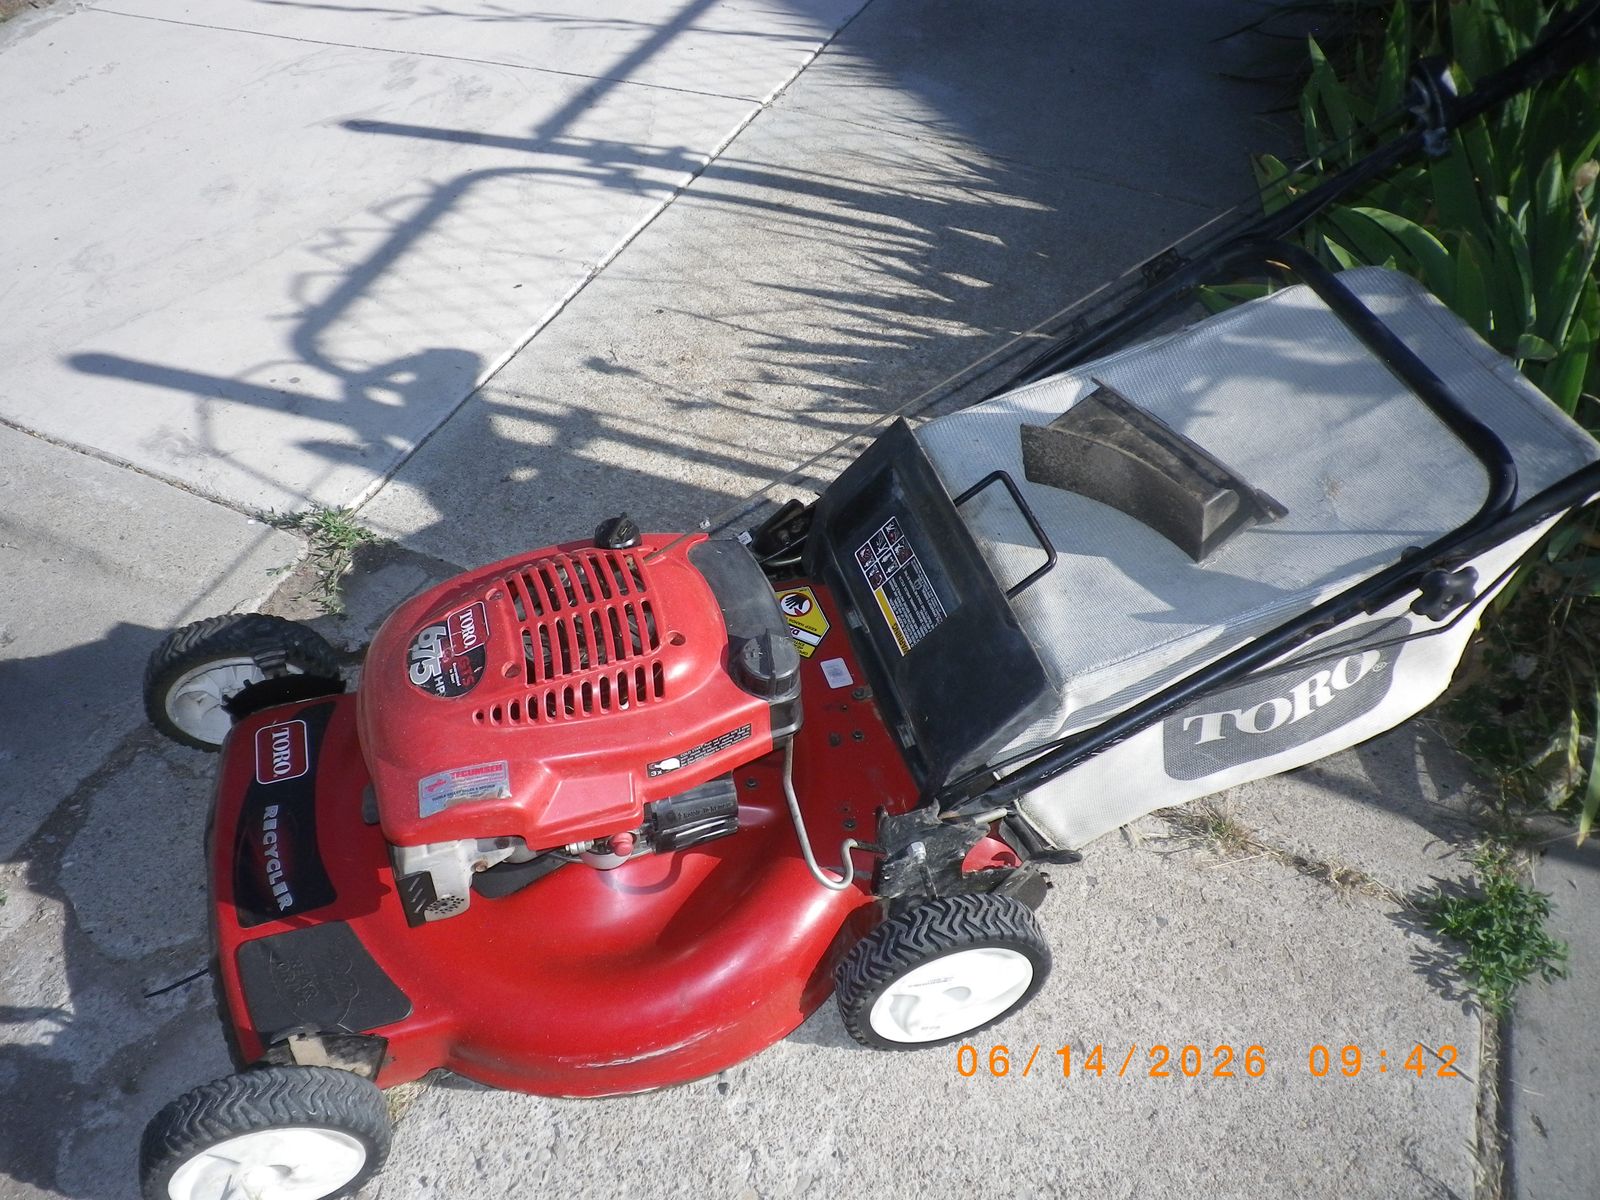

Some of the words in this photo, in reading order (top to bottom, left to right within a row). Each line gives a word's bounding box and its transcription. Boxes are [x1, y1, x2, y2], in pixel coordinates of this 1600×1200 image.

[459, 608, 477, 648] TORO
[434, 674, 446, 695] HP
[1183, 650, 1381, 745] TORO
[271, 727, 292, 777] TORO
[262, 804, 293, 911] RECYCLER
